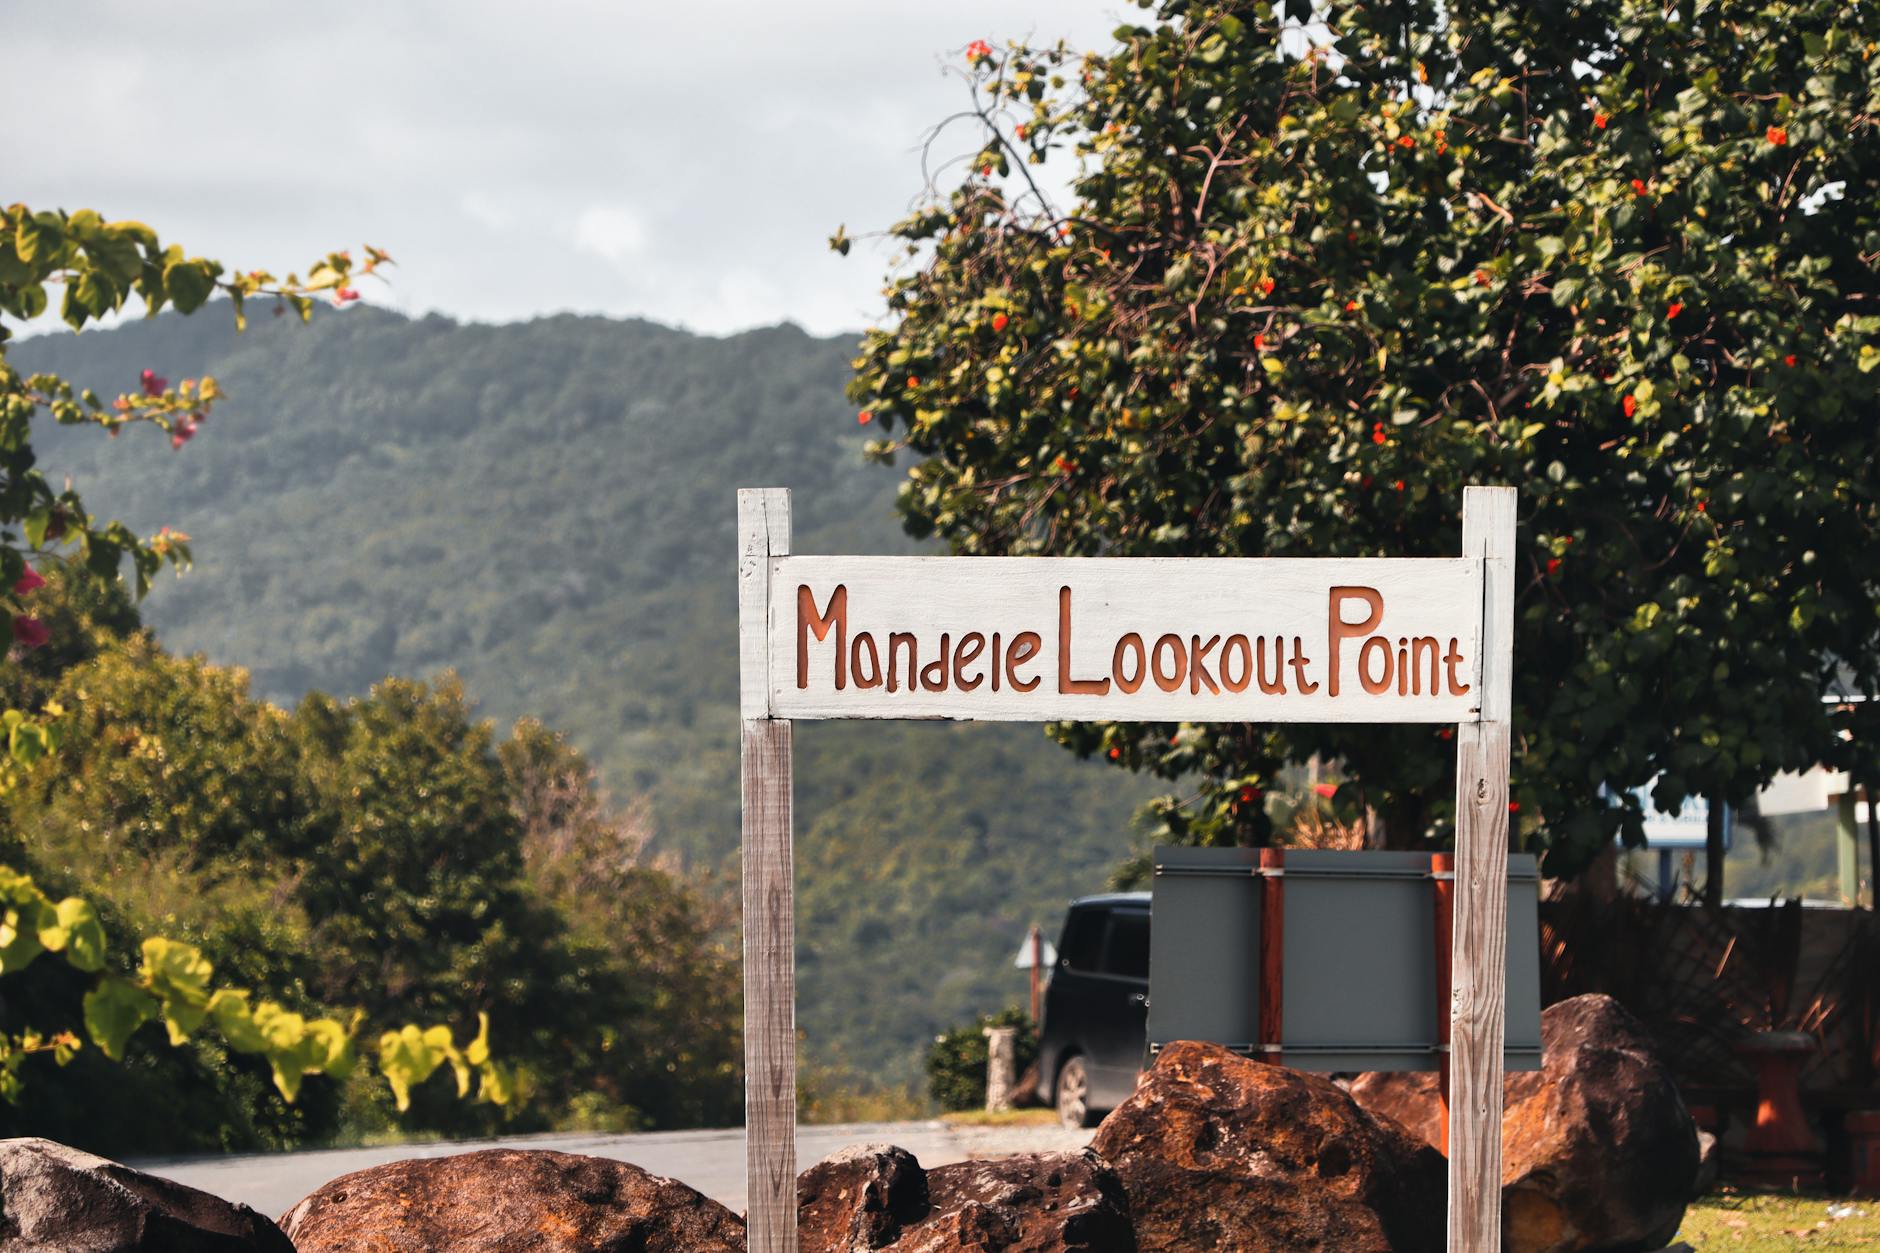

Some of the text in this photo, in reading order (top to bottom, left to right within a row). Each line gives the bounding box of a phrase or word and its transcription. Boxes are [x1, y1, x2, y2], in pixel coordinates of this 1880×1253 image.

[797, 584, 1471, 698] Mandele Lookout Point
